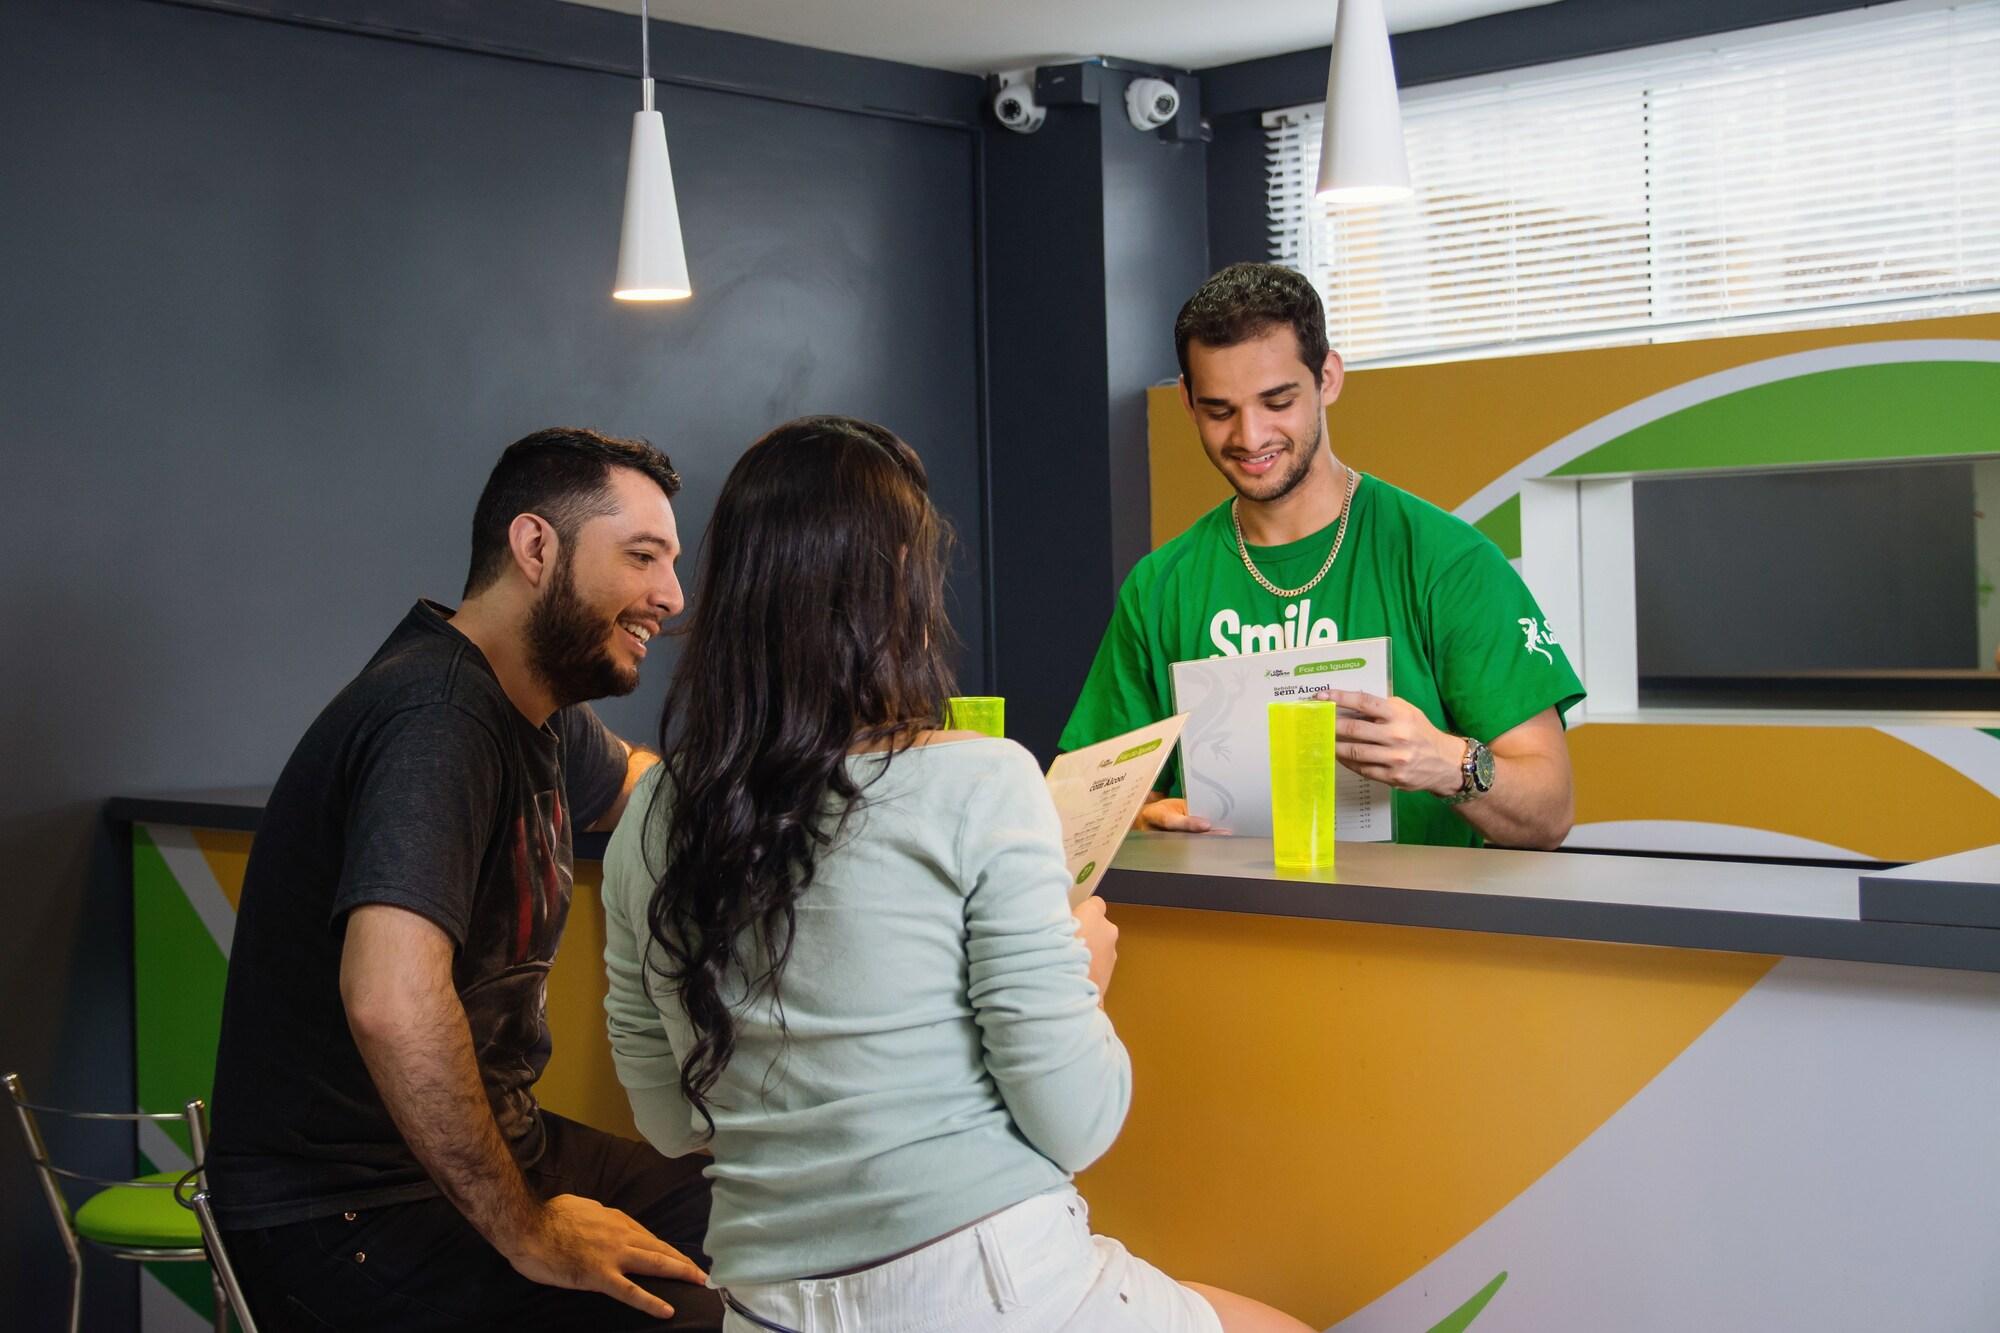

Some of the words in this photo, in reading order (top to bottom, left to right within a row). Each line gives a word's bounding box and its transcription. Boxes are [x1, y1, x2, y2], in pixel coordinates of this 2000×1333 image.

[1209, 599, 1338, 657] Smile
[1299, 665, 1314, 673] Foz
[1316, 663, 1328, 671] do
[1330, 661, 1360, 670] Iguaçu
[1274, 689, 1295, 697] sem
